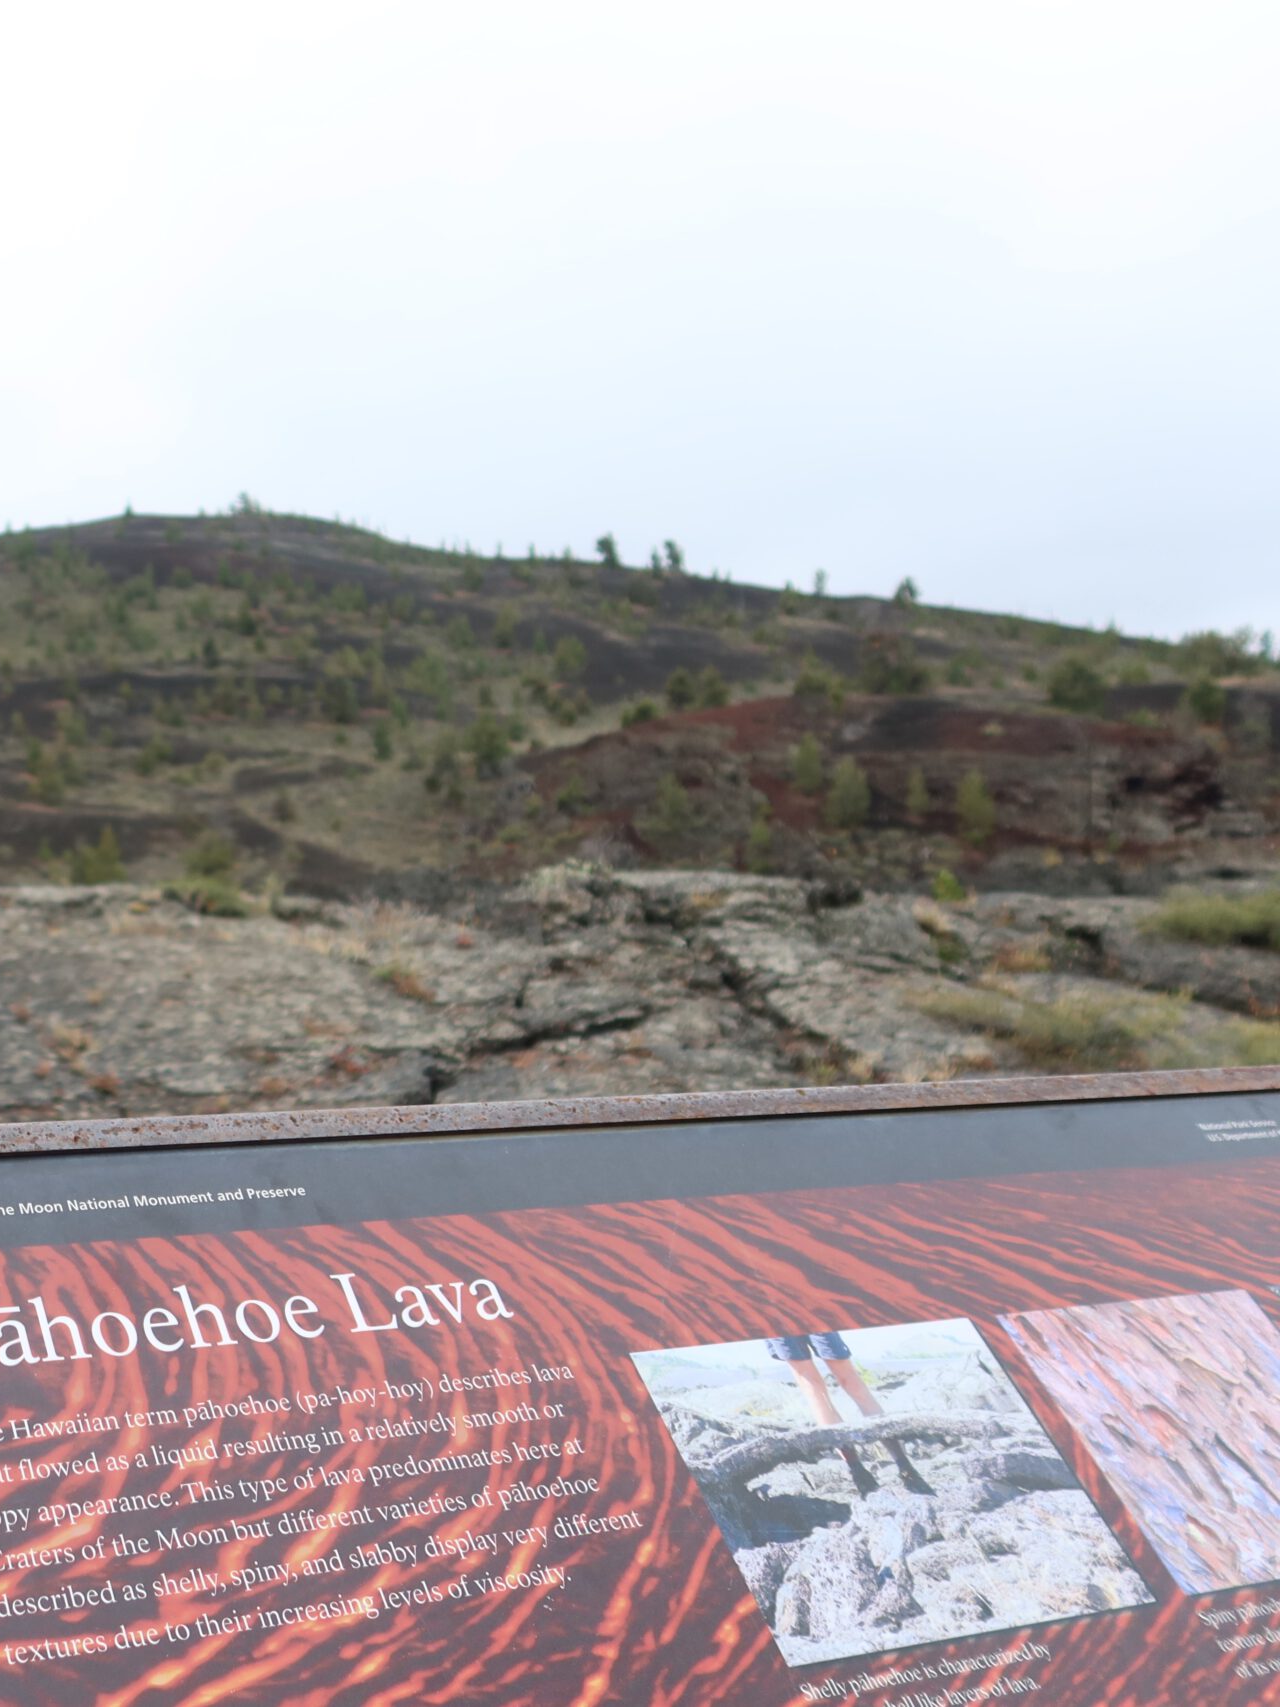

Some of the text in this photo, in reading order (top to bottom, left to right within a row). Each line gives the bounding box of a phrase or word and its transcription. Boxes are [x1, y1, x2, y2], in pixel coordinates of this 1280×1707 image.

[19, 1199, 63, 1214] Moon
[66, 1196, 130, 1212] National
[134, 1191, 214, 1207] Monument
[217, 1187, 243, 1202] and
[246, 1184, 306, 1200] Preserve
[329, 1273, 514, 1333] Lava
[8, 1412, 120, 1439] Hawaiian
[124, 1406, 178, 1429] term
[182, 1393, 292, 1425] pāhoehoe
[296, 1376, 434, 1415] (pa-hoy-hoy)
[438, 1367, 532, 1394] describes
[532, 1362, 575, 1382] lava
[17, 1452, 100, 1481] flowed
[105, 1452, 130, 1471] as
[135, 1450, 149, 1468] a
[153, 1438, 219, 1470] liquid
[222, 1430, 321, 1459] resulting
[320, 1427, 345, 1447] in
[348, 1426, 362, 1443] a
[364, 1411, 459, 1441] relatively
[463, 1402, 539, 1429] smooth
[543, 1401, 566, 1418] or
[37, 1489, 180, 1528] appearance.
[180, 1478, 235, 1505] This
[238, 1473, 289, 1503] type
[293, 1467, 318, 1490] of
[320, 1464, 365, 1489] lava
[367, 1446, 513, 1488] predominates
[512, 1438, 561, 1462] here
[565, 1436, 585, 1456] at
[81, 1536, 106, 1562] of
[111, 1533, 151, 1557] the
[155, 1527, 230, 1552] Moon
[232, 1519, 273, 1541] but
[277, 1504, 375, 1537] different
[377, 1488, 467, 1522] varieties
[471, 1486, 495, 1510] of
[497, 1473, 600, 1513] pāhoehoe
[121, 1582, 148, 1602] as
[153, 1567, 227, 1598] shelly,
[230, 1559, 298, 1592] spiny,
[301, 1550, 345, 1577] and
[349, 1538, 418, 1569] slabby
[424, 1526, 498, 1560] display
[503, 1523, 549, 1548] very
[553, 1509, 643, 1541] different
[3, 1563, 572, 1666] textures due to their increasing levels of viscosity.
[1198, 1608, 1239, 1630] Spiny
[800, 1642, 1052, 1701] Shelly pāhoehoe is characterized by
[914, 1692, 947, 1707] like
[991, 1678, 1008, 1697] of
[1004, 1676, 1041, 1694] lava.
